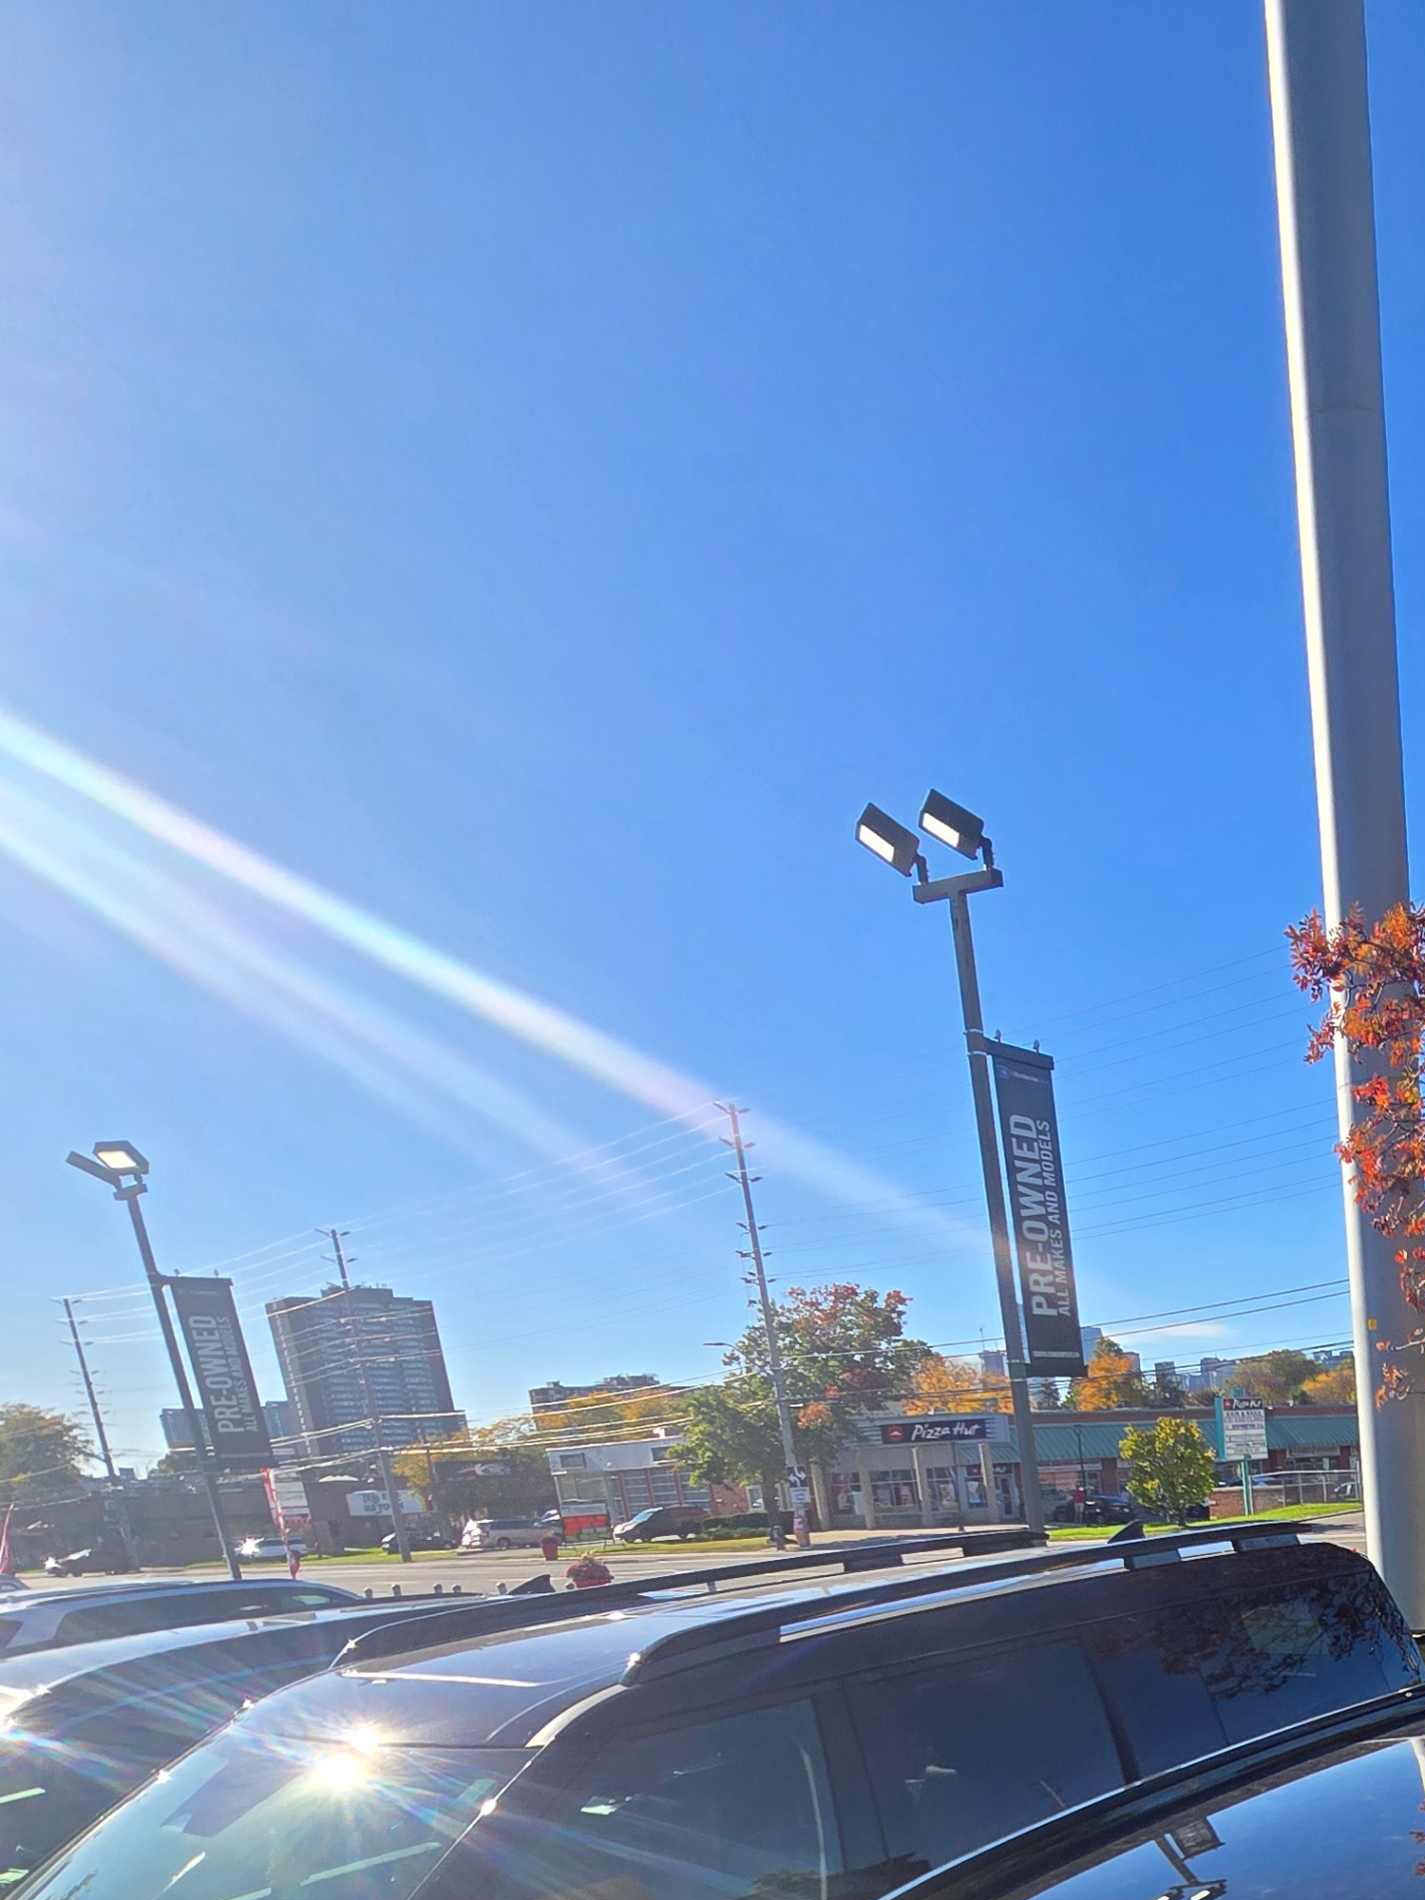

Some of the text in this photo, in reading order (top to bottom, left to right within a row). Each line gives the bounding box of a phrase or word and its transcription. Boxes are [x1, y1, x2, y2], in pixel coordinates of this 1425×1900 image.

[1009, 1114, 1058, 1317] PRE-OWNED
[1037, 1120, 1071, 1316] ALL MAKES AND MODELS
[189, 1315, 245, 1433] PRE-OWNED
[912, 1422, 982, 1441] Pizza Hut
